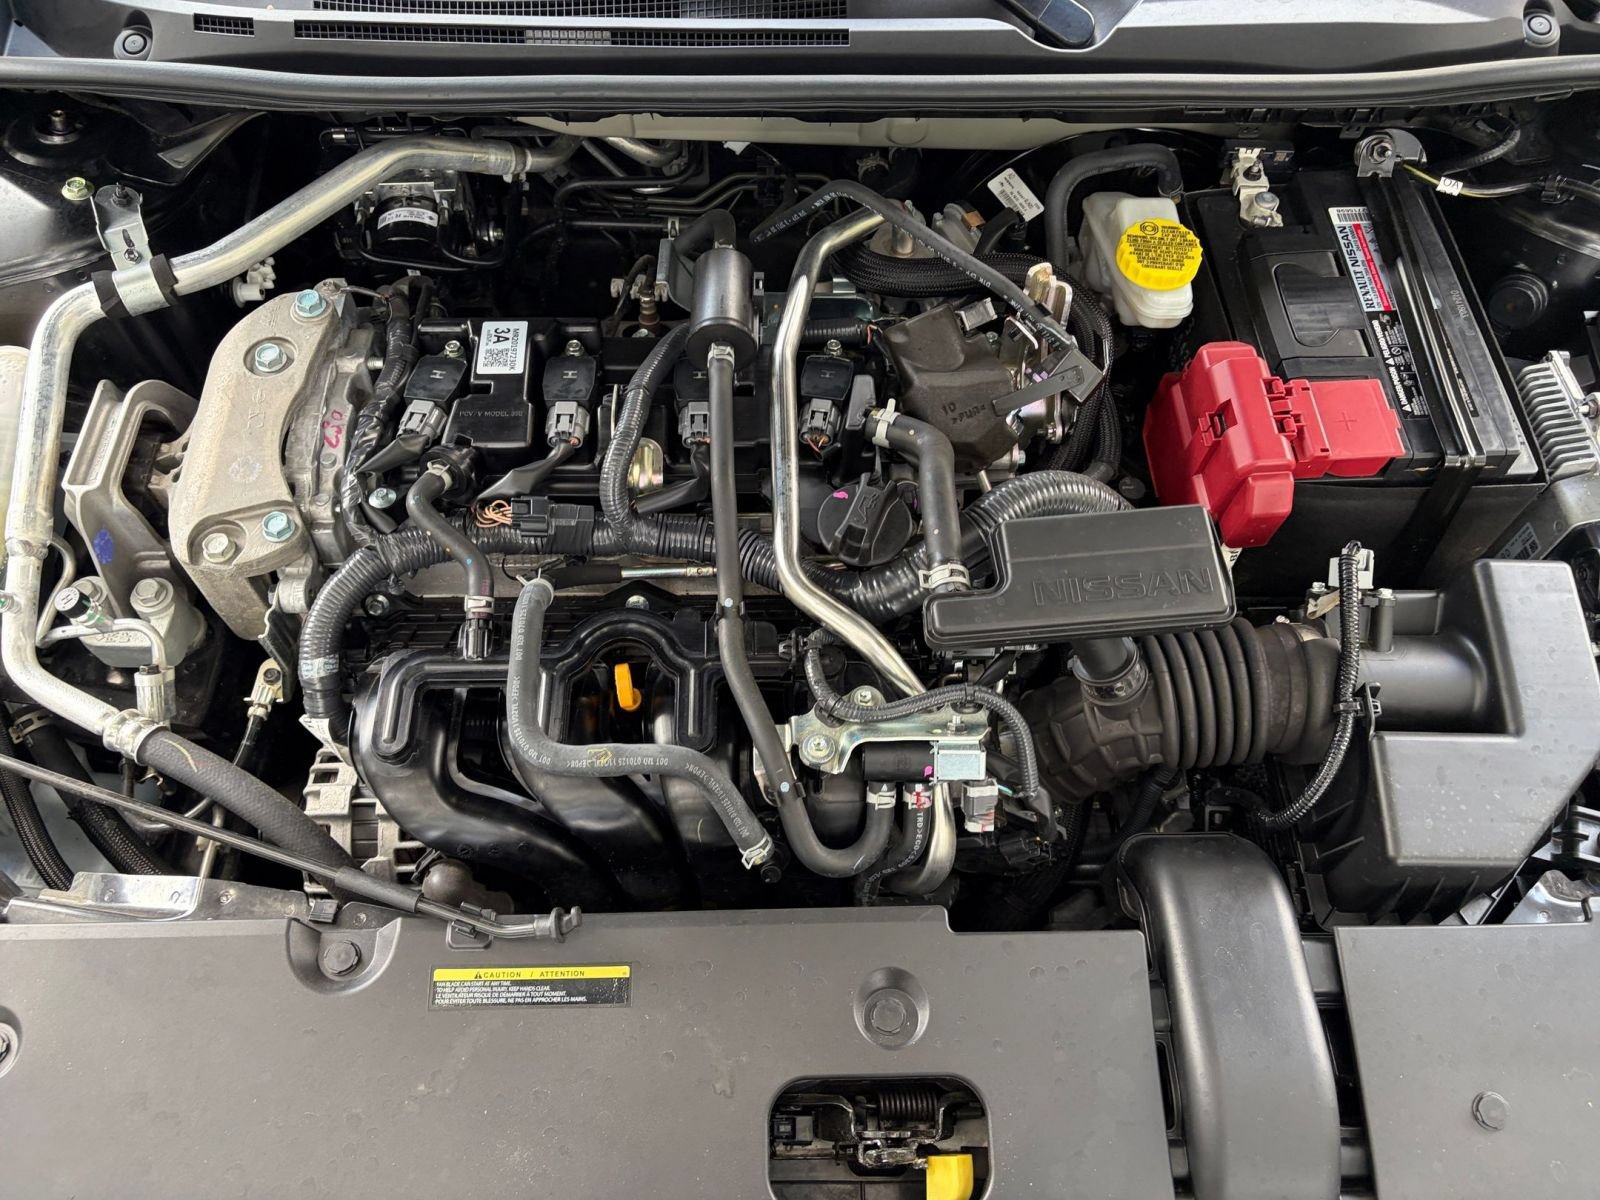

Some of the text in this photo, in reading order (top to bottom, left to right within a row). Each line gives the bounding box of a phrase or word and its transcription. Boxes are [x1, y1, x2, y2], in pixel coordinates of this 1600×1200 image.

[1337, 226, 1360, 268] NISSAN
[1352, 269, 1376, 310] RENAULT
[493, 328, 511, 344] 3A
[1032, 568, 1214, 606] NISSAN
